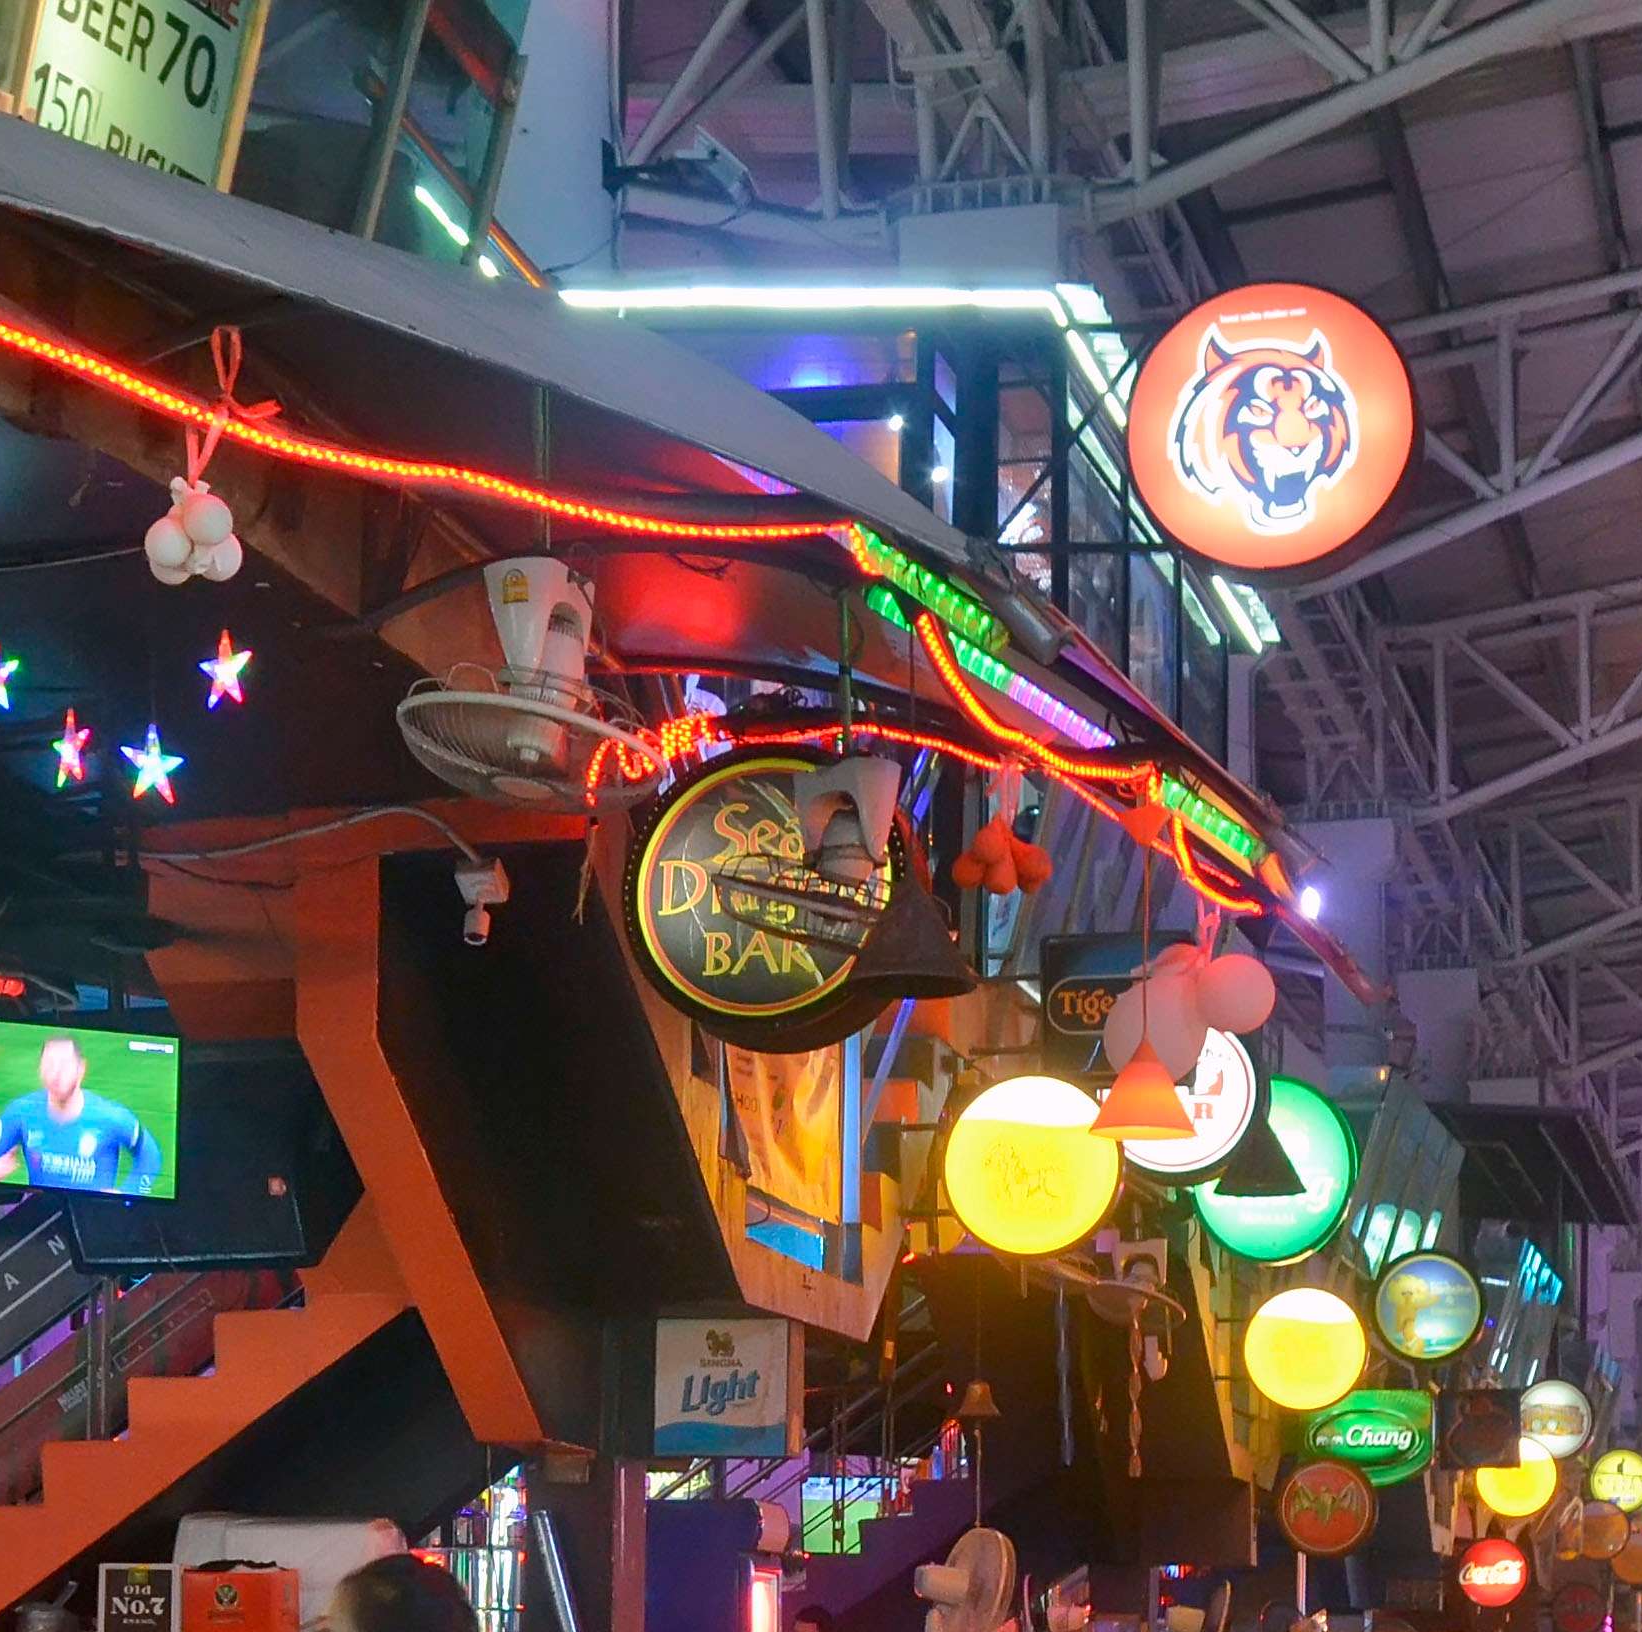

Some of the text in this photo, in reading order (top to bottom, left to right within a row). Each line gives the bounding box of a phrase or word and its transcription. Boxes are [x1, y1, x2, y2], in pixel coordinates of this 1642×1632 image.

[158, 11, 216, 109] 70
[702, 929, 818, 978] BAR
[1057, 987, 1116, 1026] Tige
[1193, 1102, 1214, 1120] R
[1344, 1424, 1413, 1450] Chang
[109, 1596, 166, 1616] No.7
